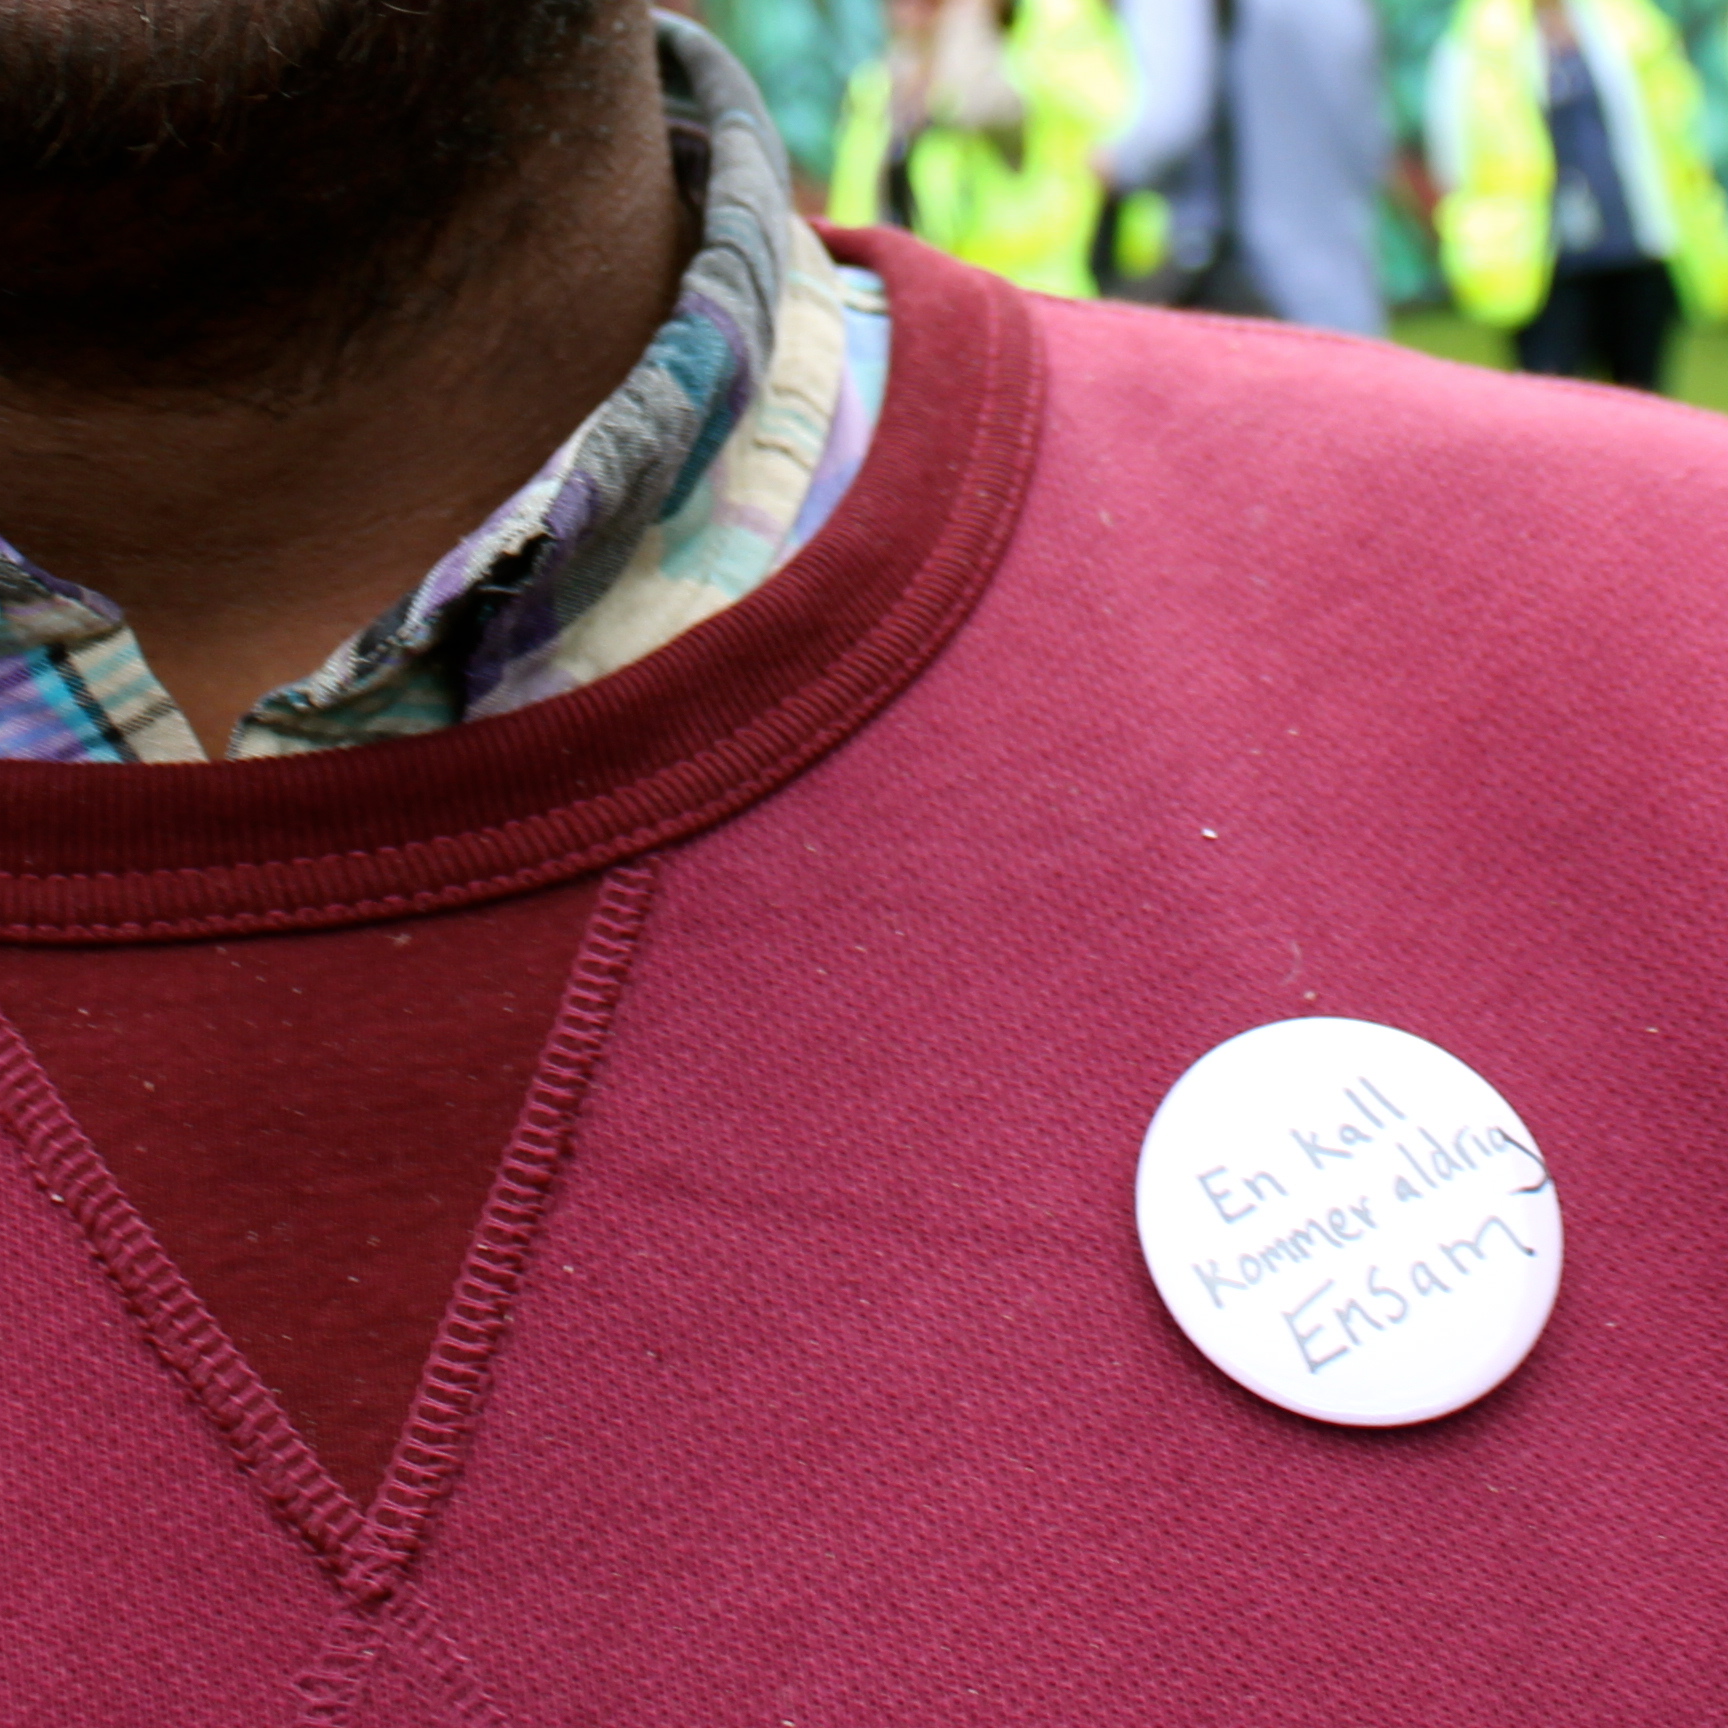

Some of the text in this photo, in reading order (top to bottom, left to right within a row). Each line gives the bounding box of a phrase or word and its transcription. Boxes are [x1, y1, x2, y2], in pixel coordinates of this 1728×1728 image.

[1198, 1165, 1289, 1224] En
[1393, 1125, 1552, 1202] aldrig
[1282, 1215, 1538, 1374] Ensam
